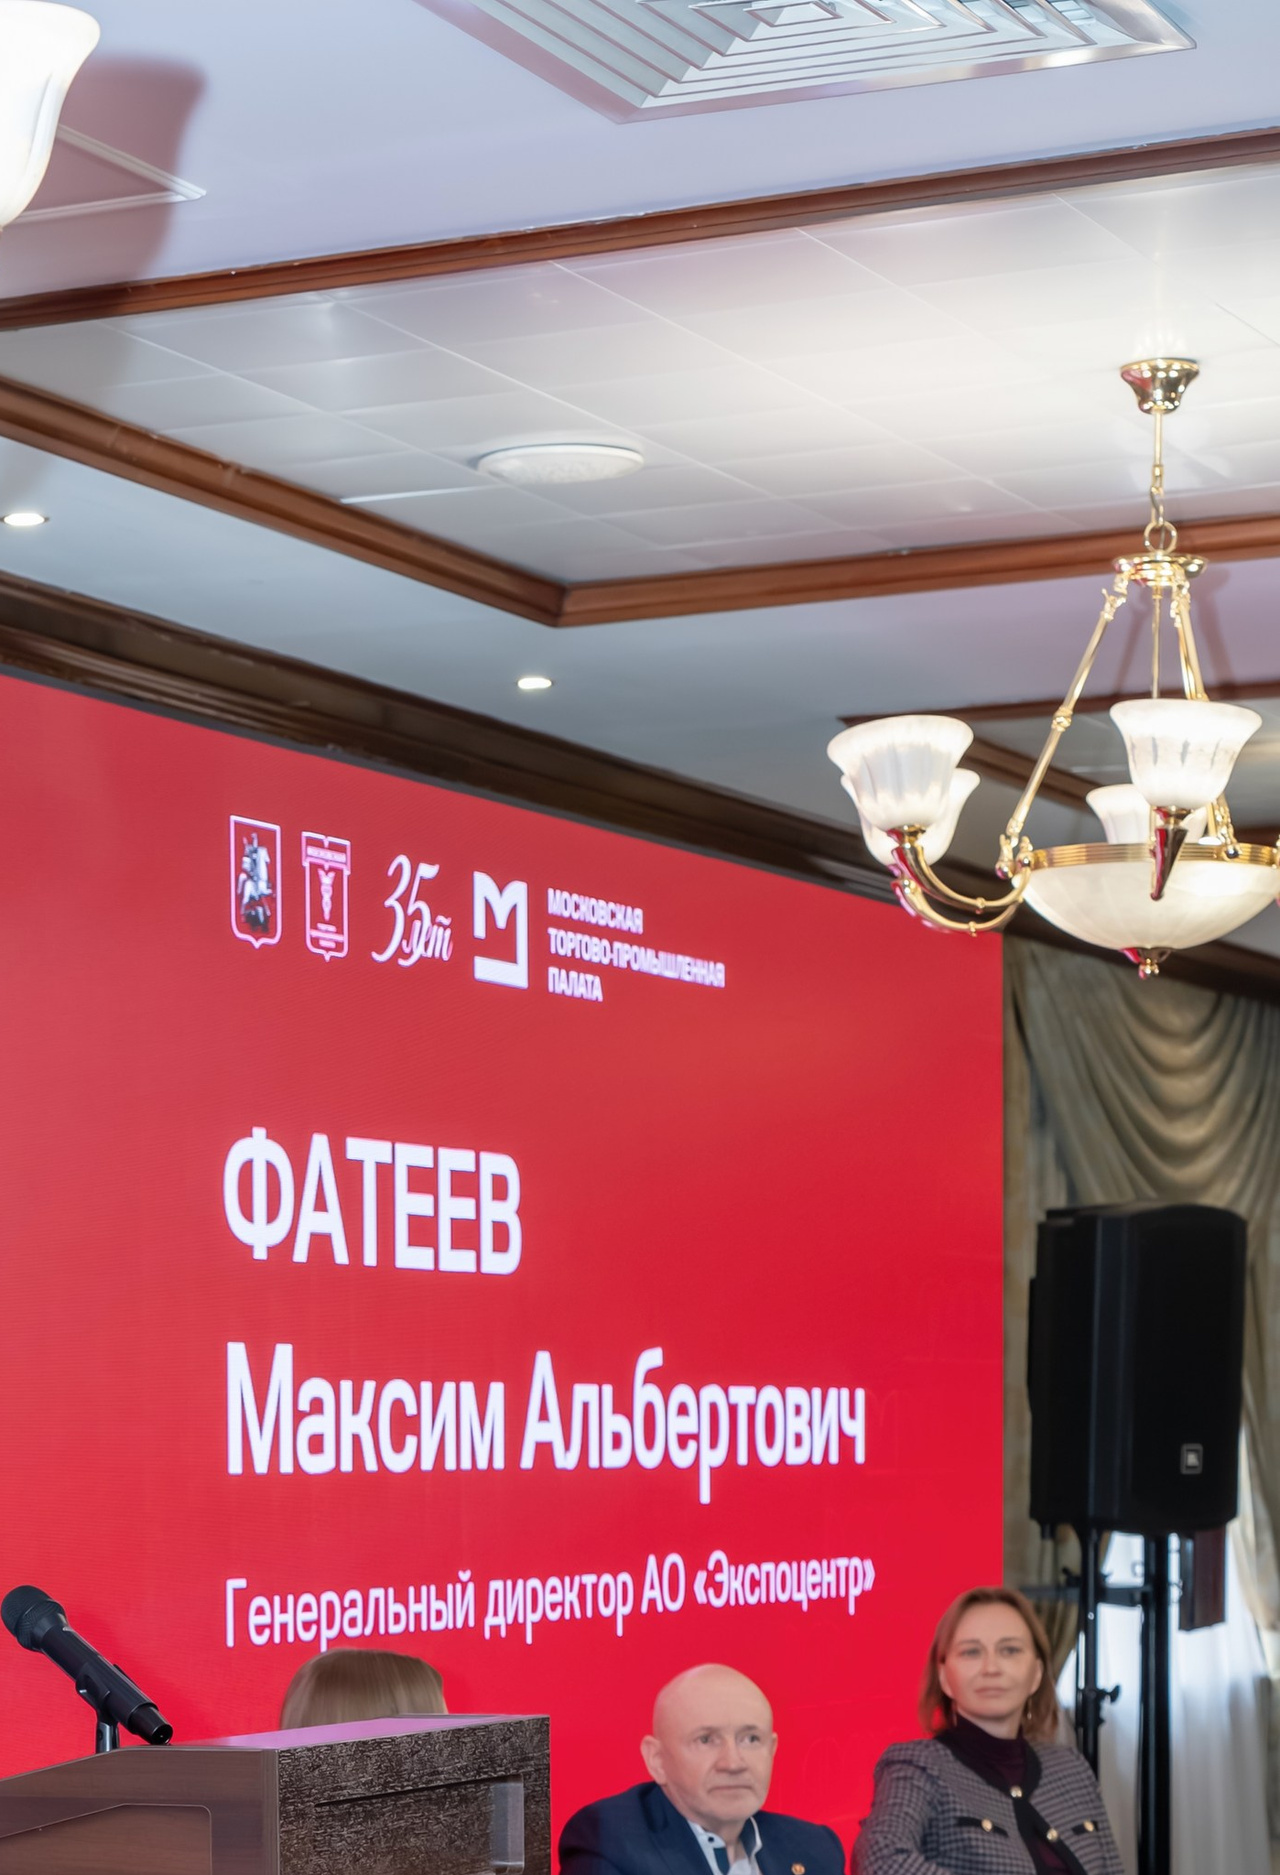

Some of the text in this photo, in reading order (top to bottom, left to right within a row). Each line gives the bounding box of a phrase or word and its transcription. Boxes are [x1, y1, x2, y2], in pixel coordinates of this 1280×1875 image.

[371, 854, 440, 967] 35
[547, 887, 643, 935] МОСКОВСКАЯ
[547, 927, 726, 988] ТОРГОВО-ПРОМЫШЛЕННАЯ
[548, 966, 604, 1002] ПАЛАТА
[222, 1126, 522, 1275] ФАТЕЕВ
[226, 1341, 866, 1504] Максим Альбертович
[225, 1550, 876, 1652] Генеральный директор АО «Экспоцентр»
